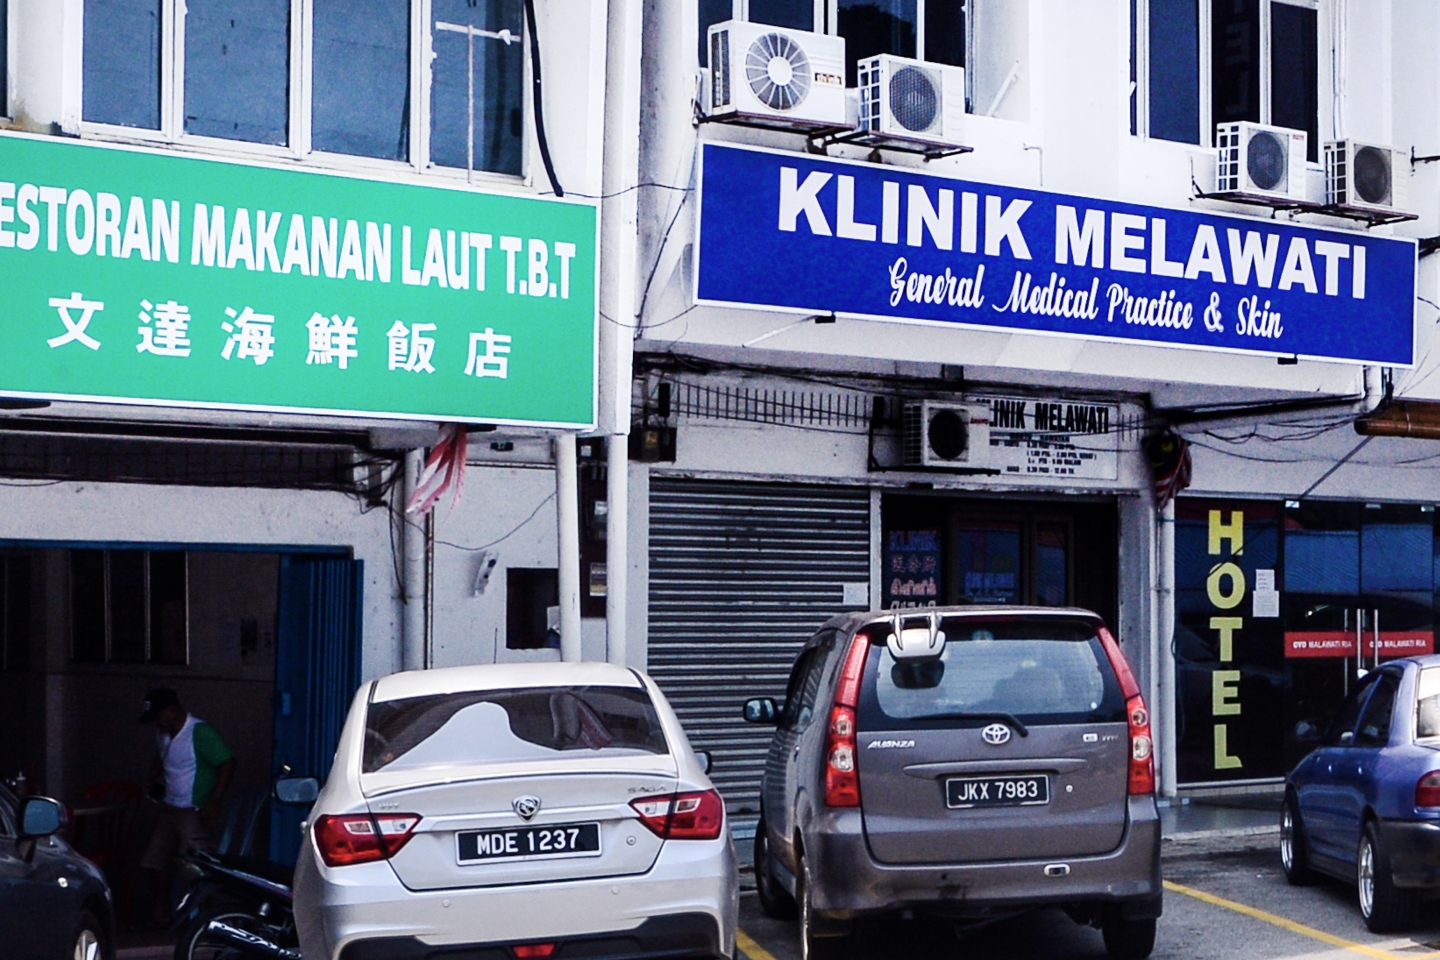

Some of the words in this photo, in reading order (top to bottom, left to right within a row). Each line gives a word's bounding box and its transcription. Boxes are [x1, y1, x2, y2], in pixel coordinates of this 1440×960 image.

[191, 202, 392, 283] MAKANAN
[402, 225, 492, 291] LAUT
[500, 235, 576, 300] T.B.T
[778, 167, 1036, 261] KLINIK
[1054, 206, 1366, 300] MELAWATI
[47, 291, 512, 379] 文達海鮮飯店
[888, 257, 985, 308] General
[992, 270, 1099, 321] Medical
[1106, 283, 1194, 332] Practice
[1203, 292, 1225, 333] &
[1236, 299, 1284, 339] Skin
[977, 398, 1026, 429] INIK
[1035, 402, 1109, 434] MELAWATI
[1207, 510, 1246, 770] HOTEL
[867, 739, 915, 749] AVANZA
[958, 782, 990, 801] JKX
[994, 780, 1039, 799] 7983
[477, 832, 519, 855] MDE
[527, 828, 580, 852] 1237
